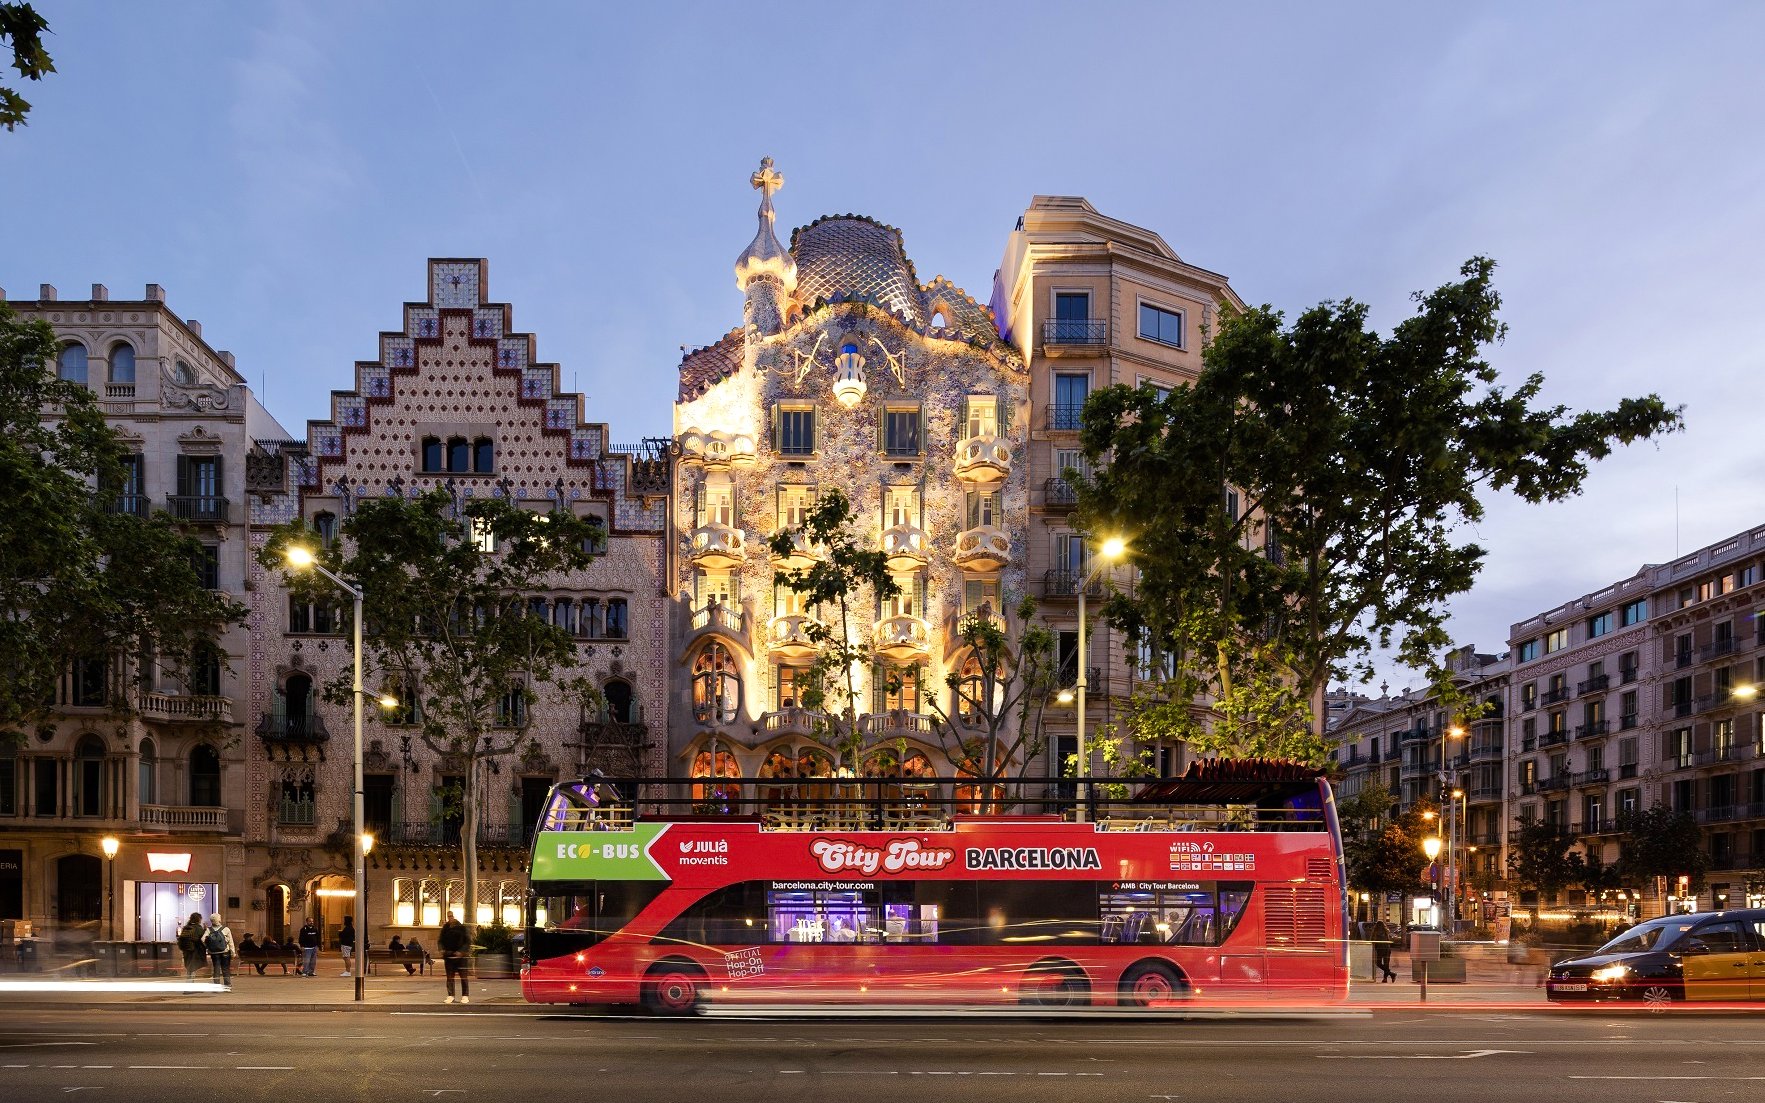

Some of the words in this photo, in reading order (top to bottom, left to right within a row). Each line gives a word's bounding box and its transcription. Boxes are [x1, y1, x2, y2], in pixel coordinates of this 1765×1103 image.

[813, 841, 880, 873] City
[884, 841, 951, 870] Tour
[965, 847, 1102, 870] BARCELONA
[772, 881, 874, 891] barcelona.city-tour.com
[1120, 882, 1136, 890] AMB
[1139, 882, 1152, 891] City
[1152, 882, 1166, 890] Tour
[1167, 882, 1200, 890] Barcelona
[724, 949, 762, 962] OFFICIAL
[726, 957, 763, 970] Hop-On
[728, 964, 764, 978] Hop-Off
